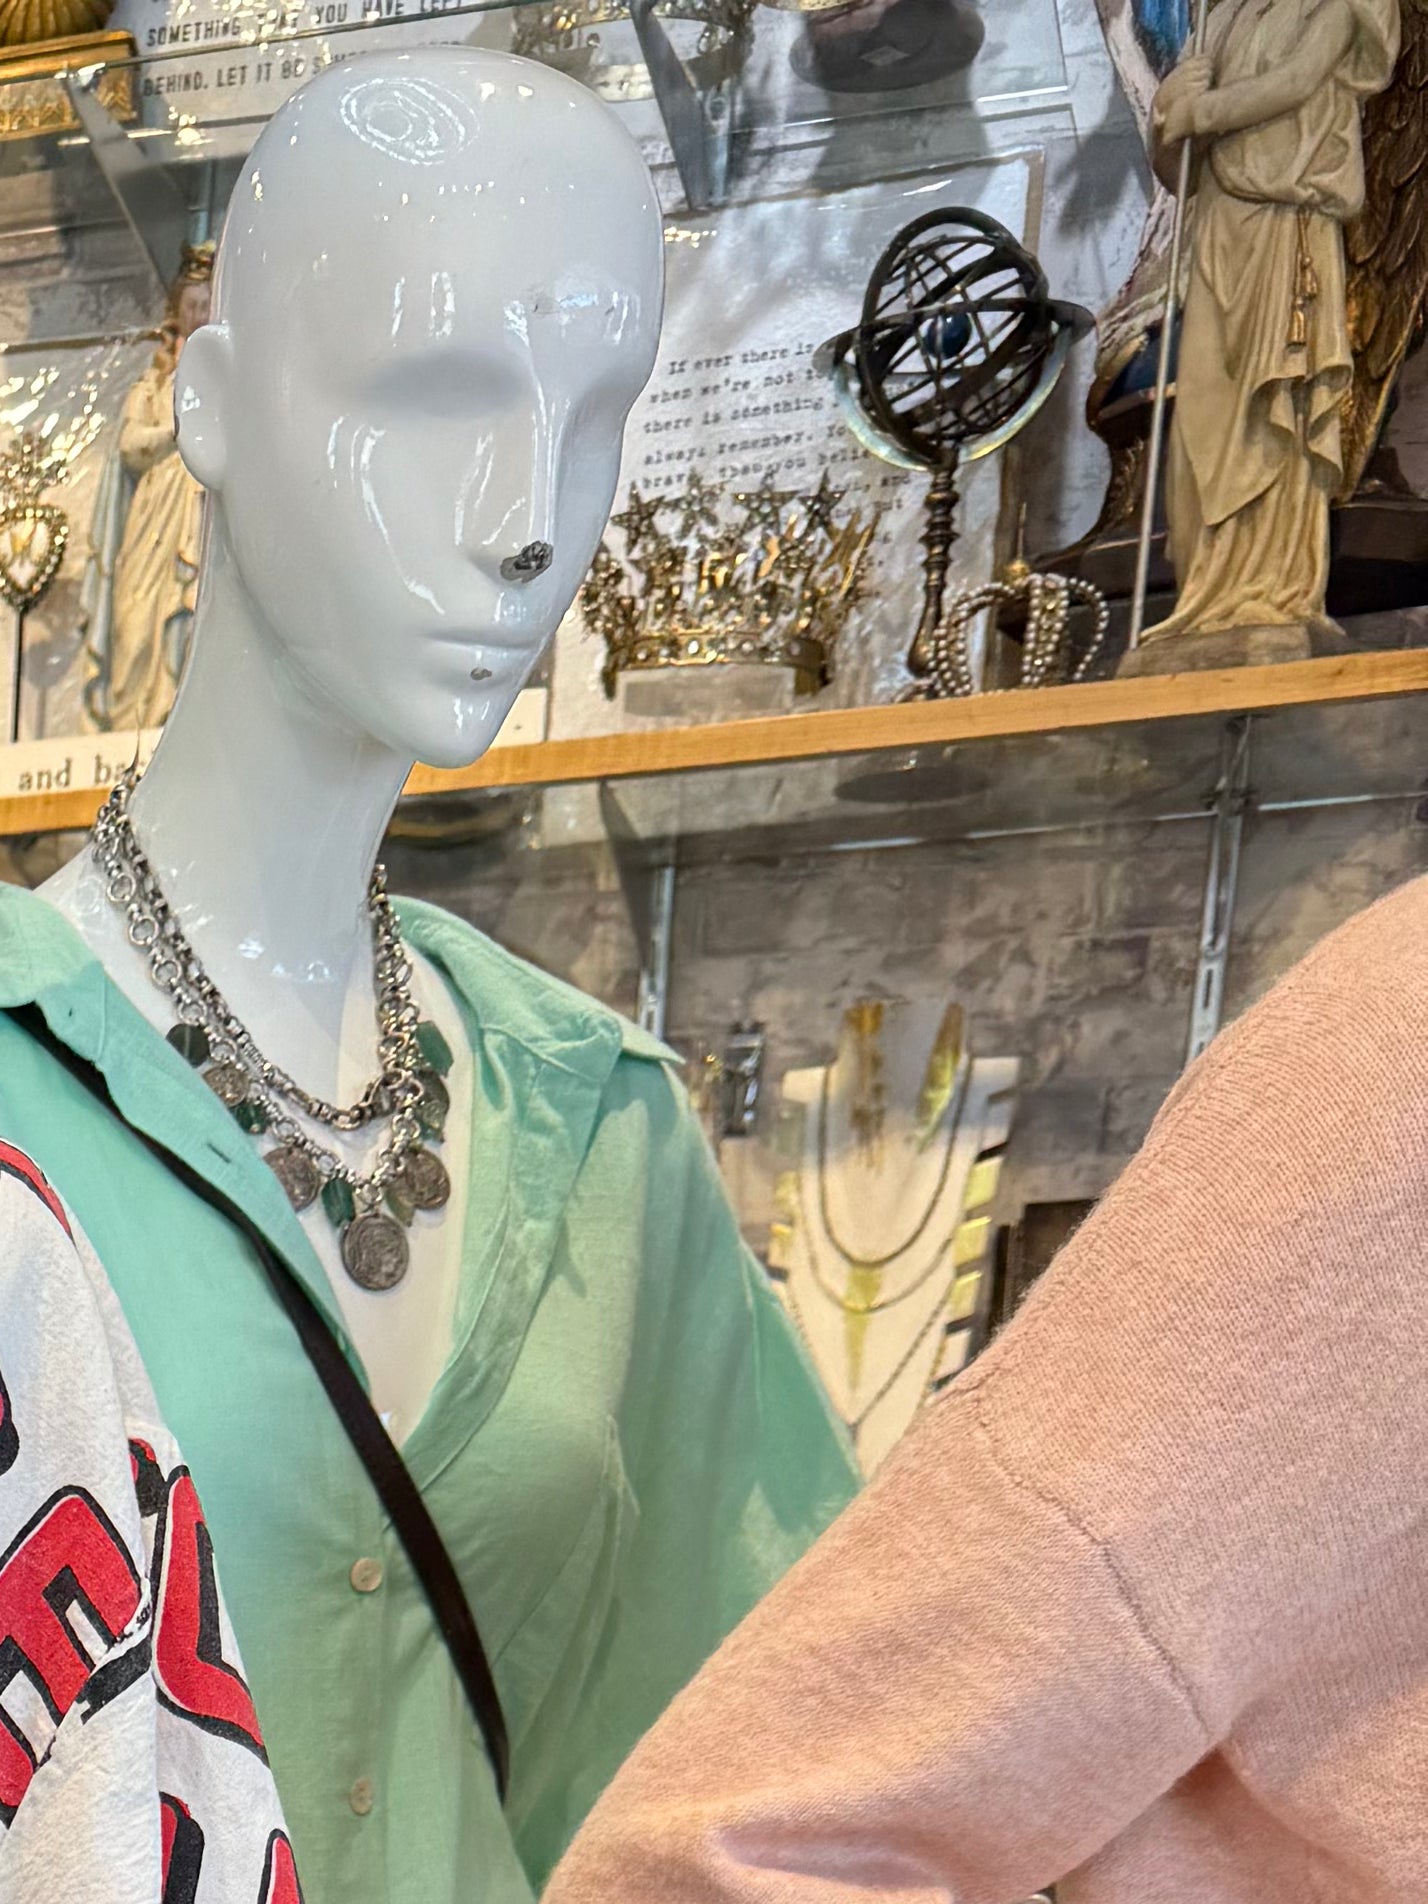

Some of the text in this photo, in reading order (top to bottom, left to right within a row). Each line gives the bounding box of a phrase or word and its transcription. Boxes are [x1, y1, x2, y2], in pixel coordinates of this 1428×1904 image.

[146, 16, 241, 47] SOMETHING
[315, 3, 348, 24] YOU
[145, 71, 209, 97] BEHIND.
[217, 66, 246, 87] LET
[256, 64, 272, 84] IT
[694, 357, 734, 371] ever
[741, 347, 788, 364] there
[763, 372, 794, 388] not
[643, 416, 693, 434] there
[702, 410, 722, 426] is
[18, 756, 73, 790] and
